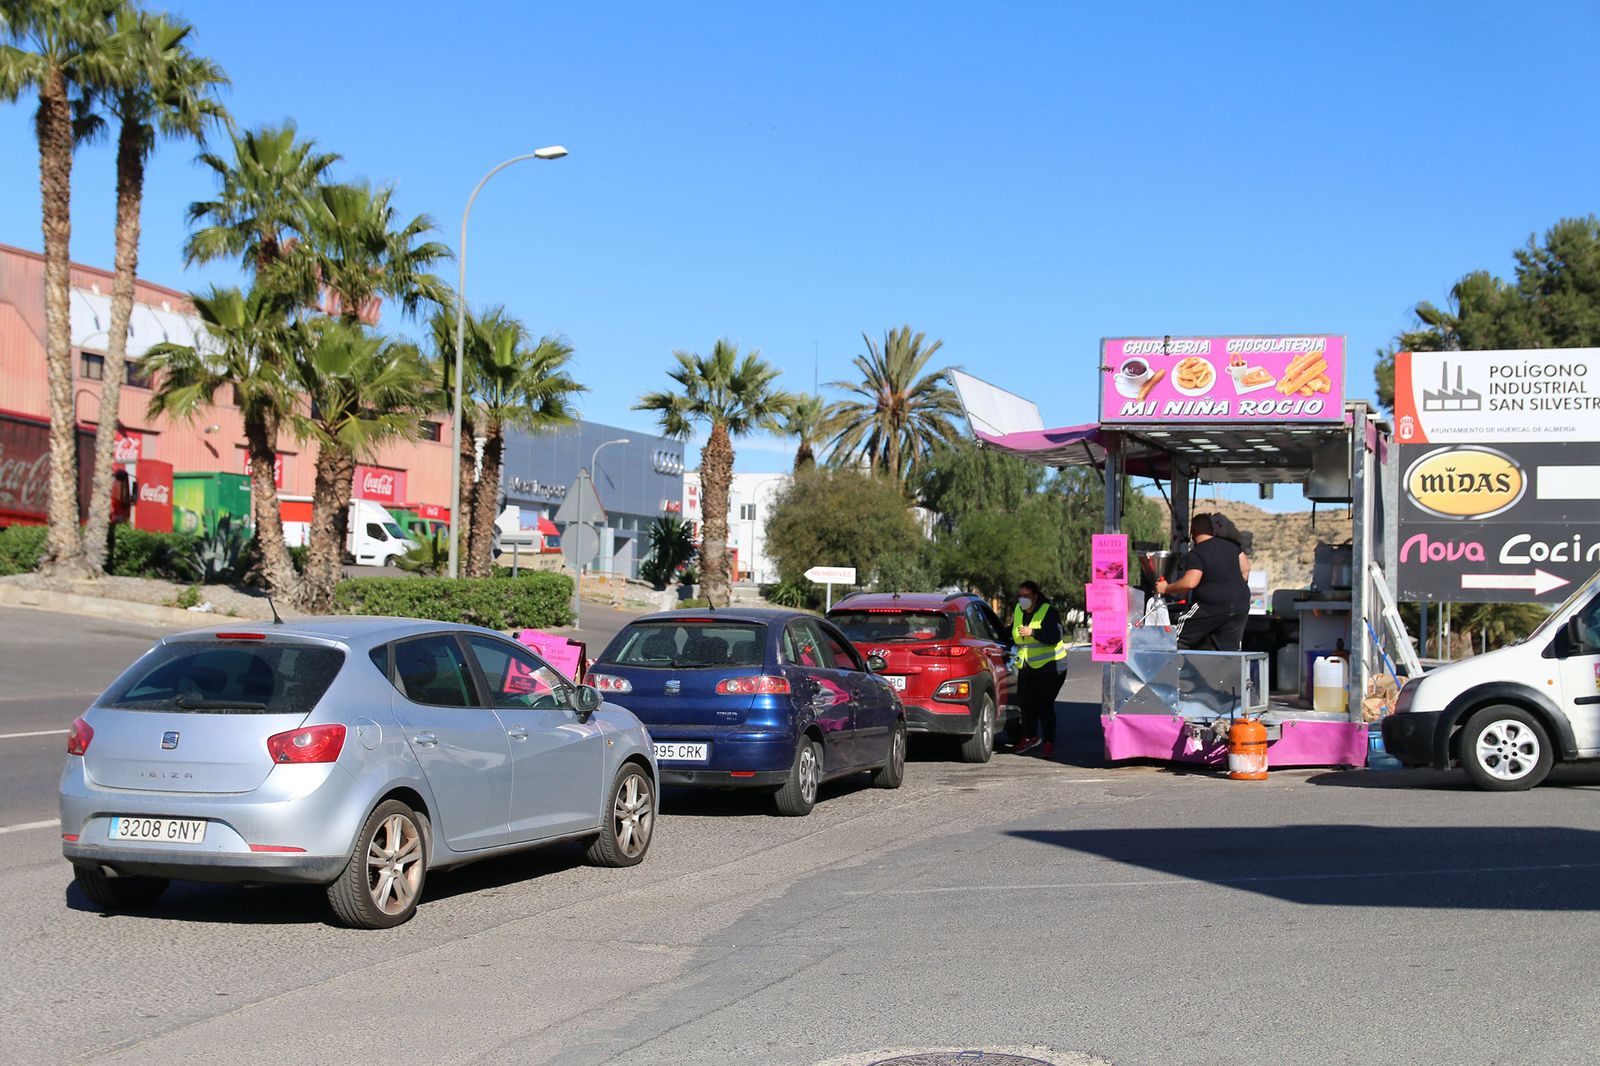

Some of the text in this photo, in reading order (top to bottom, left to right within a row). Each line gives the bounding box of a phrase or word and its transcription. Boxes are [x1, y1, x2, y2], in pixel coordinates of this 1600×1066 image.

[1123, 337, 1326, 355] CHURRERIA CHOCOLATERIA
[1490, 360, 1588, 378] POLÍGONO
[1489, 381, 1588, 395] INDUSTRIAL
[1120, 396, 1325, 417] MI NIÑA ROCIO
[1489, 398, 1524, 411] SAN
[678, 745, 703, 758] CRK
[141, 771, 193, 779] IBIZA
[120, 818, 201, 840] 3208 GNY
